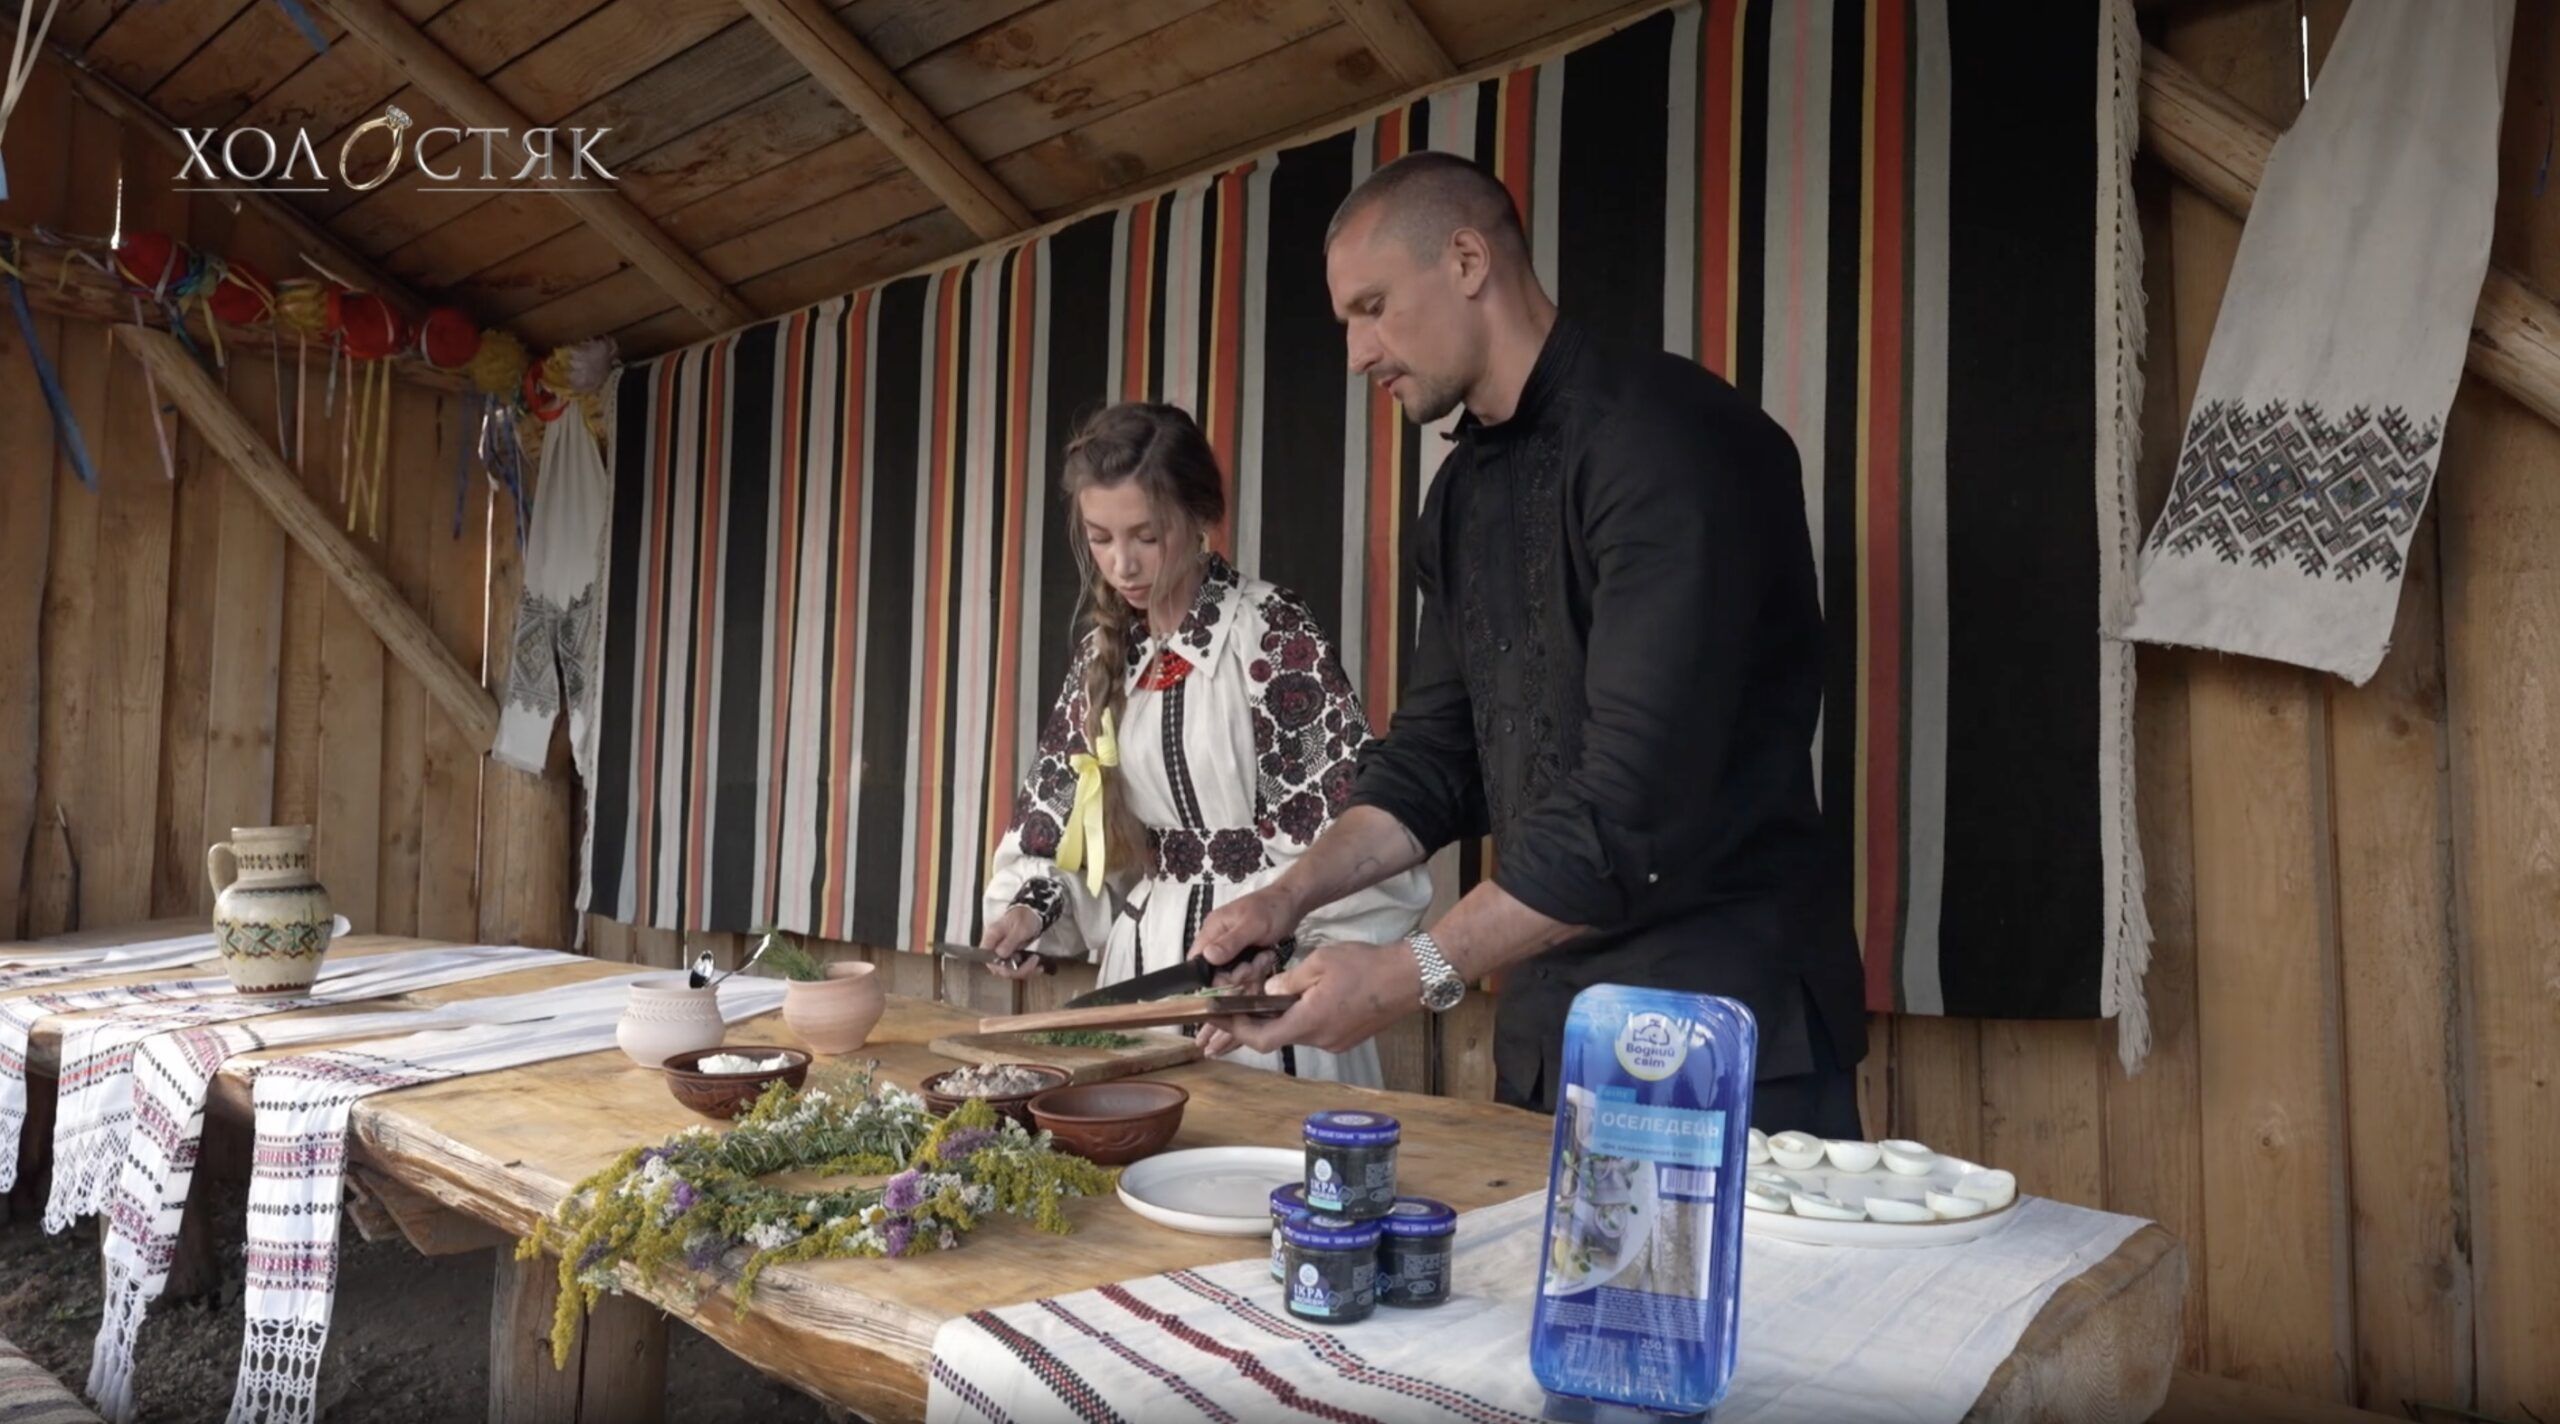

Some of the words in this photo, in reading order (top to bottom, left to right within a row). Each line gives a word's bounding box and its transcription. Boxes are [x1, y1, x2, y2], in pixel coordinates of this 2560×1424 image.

[1626, 1042, 1676, 1058] Водний
[1634, 1056, 1666, 1068] світ
[1600, 1111, 1720, 1137] ОСЕЛЕДЕЦЬ
[1294, 1284, 1324, 1299] ІКРА
[1640, 1338, 1663, 1351] 250
